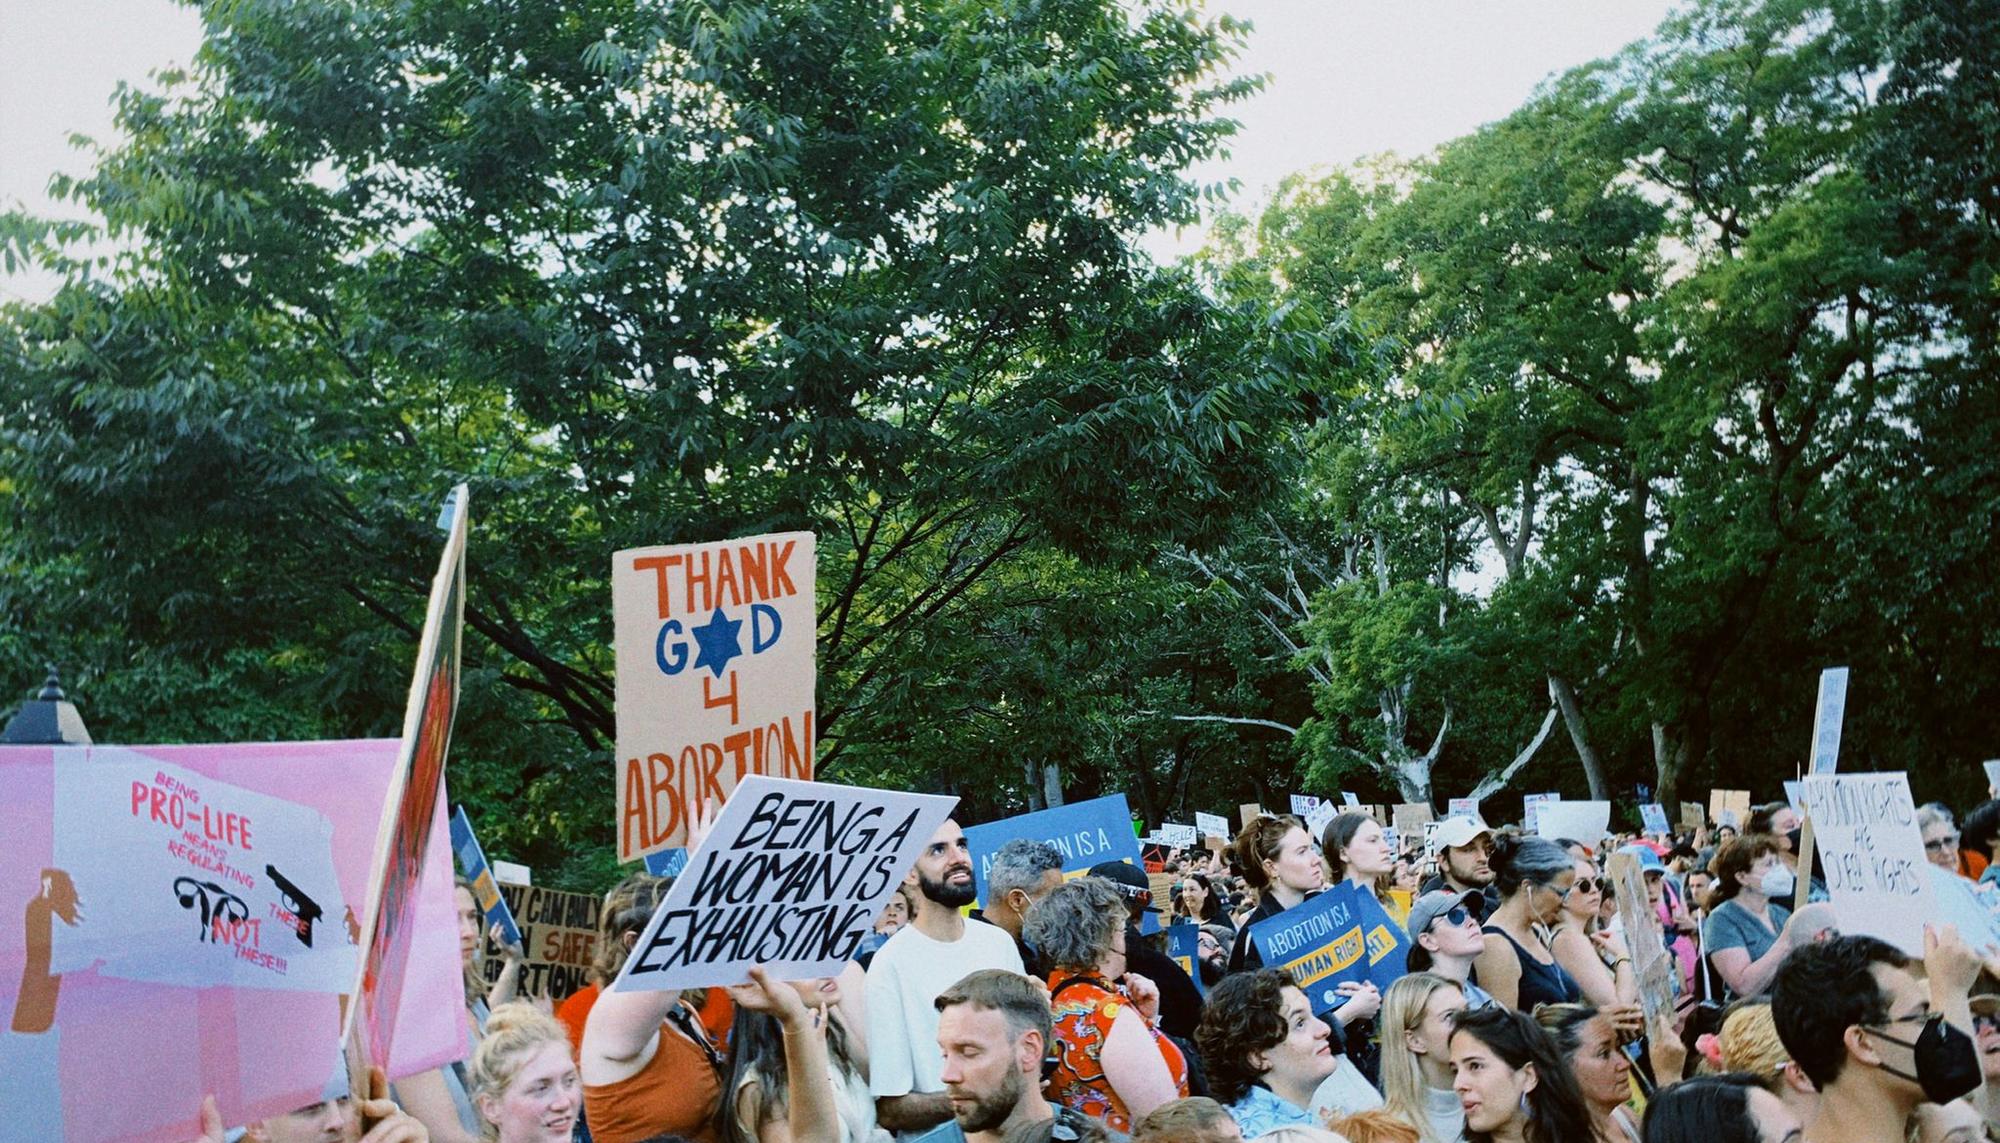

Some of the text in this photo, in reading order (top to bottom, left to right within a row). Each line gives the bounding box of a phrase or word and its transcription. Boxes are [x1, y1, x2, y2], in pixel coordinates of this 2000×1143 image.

[633, 540, 797, 619] THANK
[704, 670, 739, 725] 4
[155, 771, 200, 803] BEING
[622, 711, 812, 857] ABORTION
[131, 781, 253, 850] PRO-LIFE
[731, 792, 921, 855] BEING A
[182, 830, 228, 861] MEANS
[1074, 828, 1112, 857] IS A
[167, 839, 255, 889] REGULATING
[689, 850, 856, 907] WOMAN
[847, 855, 897, 901] IS
[268, 902, 310, 936] THESE
[527, 887, 564, 926] CAN
[212, 915, 262, 948] NOT
[543, 931, 595, 966] SAFE
[629, 904, 870, 975] EXHAUSTING
[1172, 936, 1181, 951] A
[1267, 902, 1351, 959] ABORTION IS A
[234, 943, 288, 976] THESE!!!
[484, 959, 594, 999] ABRTIONS
[1291, 951, 1334, 984] UMAN
